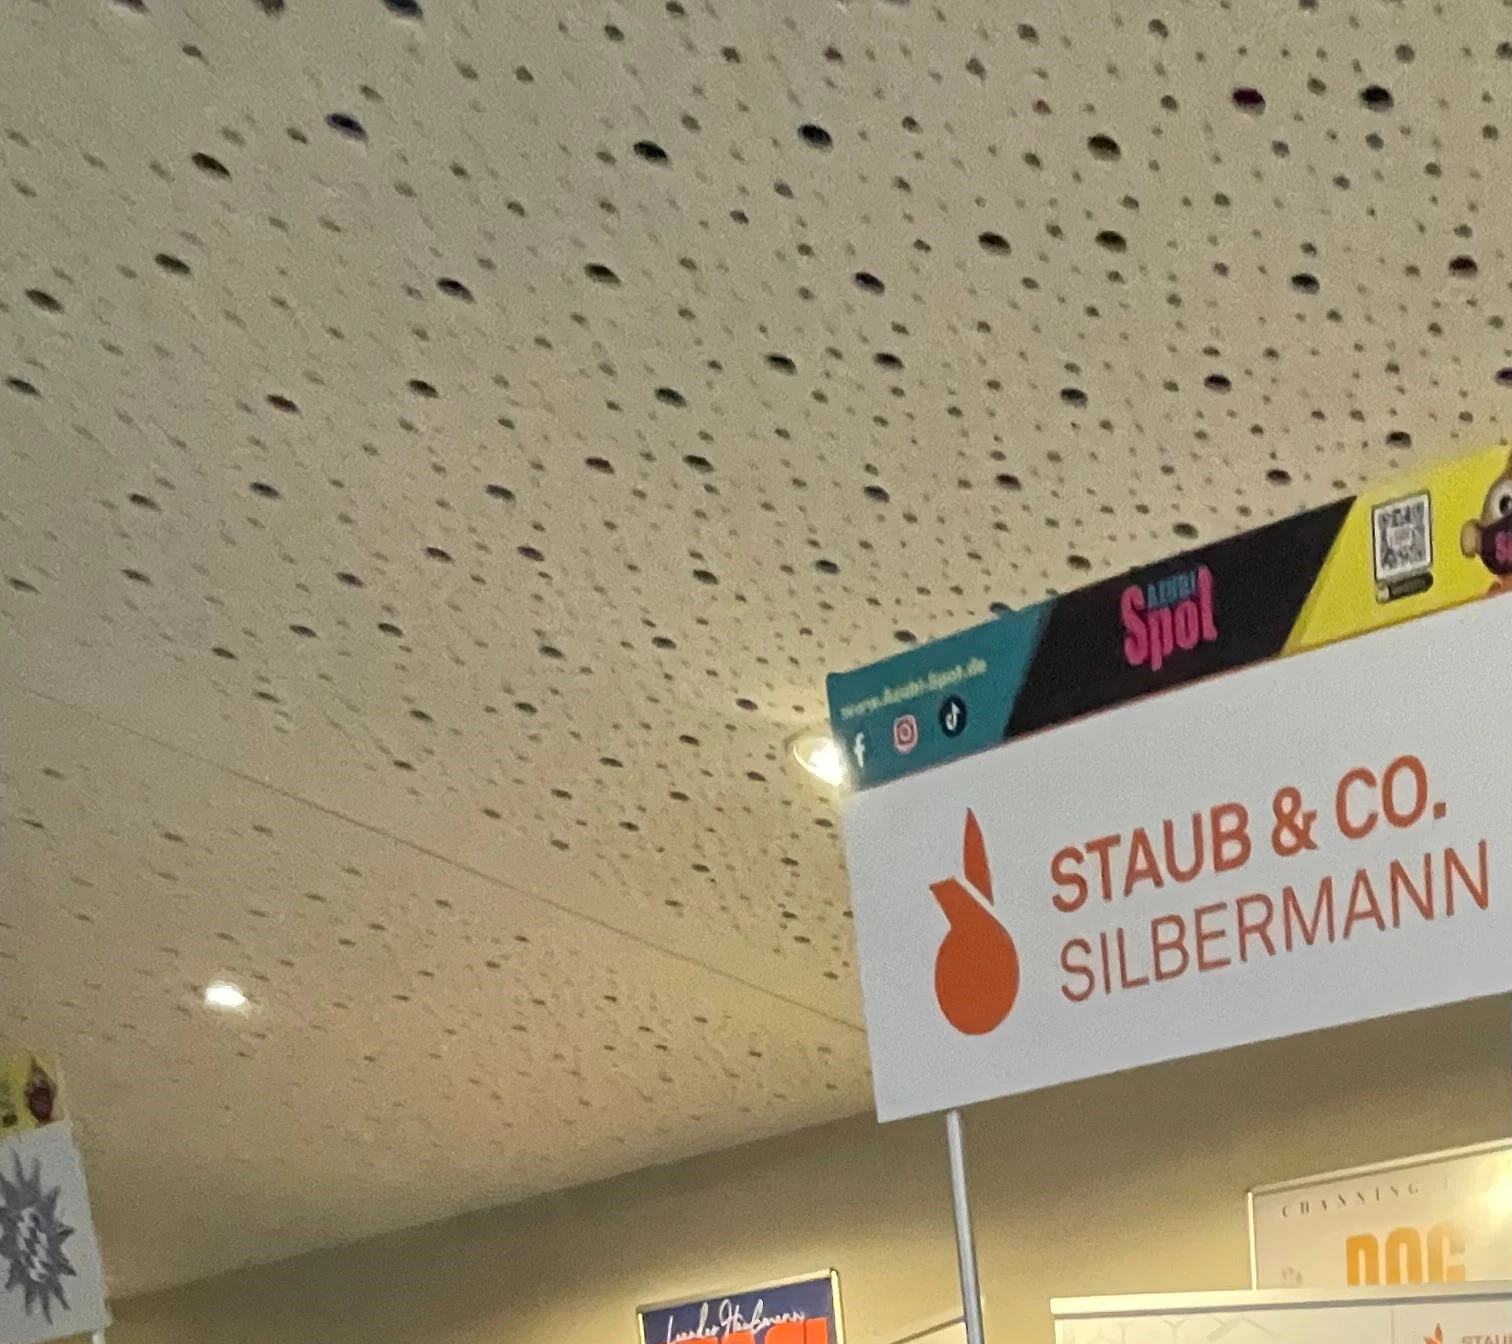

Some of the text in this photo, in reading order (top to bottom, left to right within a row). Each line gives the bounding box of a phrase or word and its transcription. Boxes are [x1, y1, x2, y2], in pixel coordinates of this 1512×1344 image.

[1050, 754, 1447, 914] STAUB & CO.
[1059, 839, 1492, 1003] SILBERMANN
